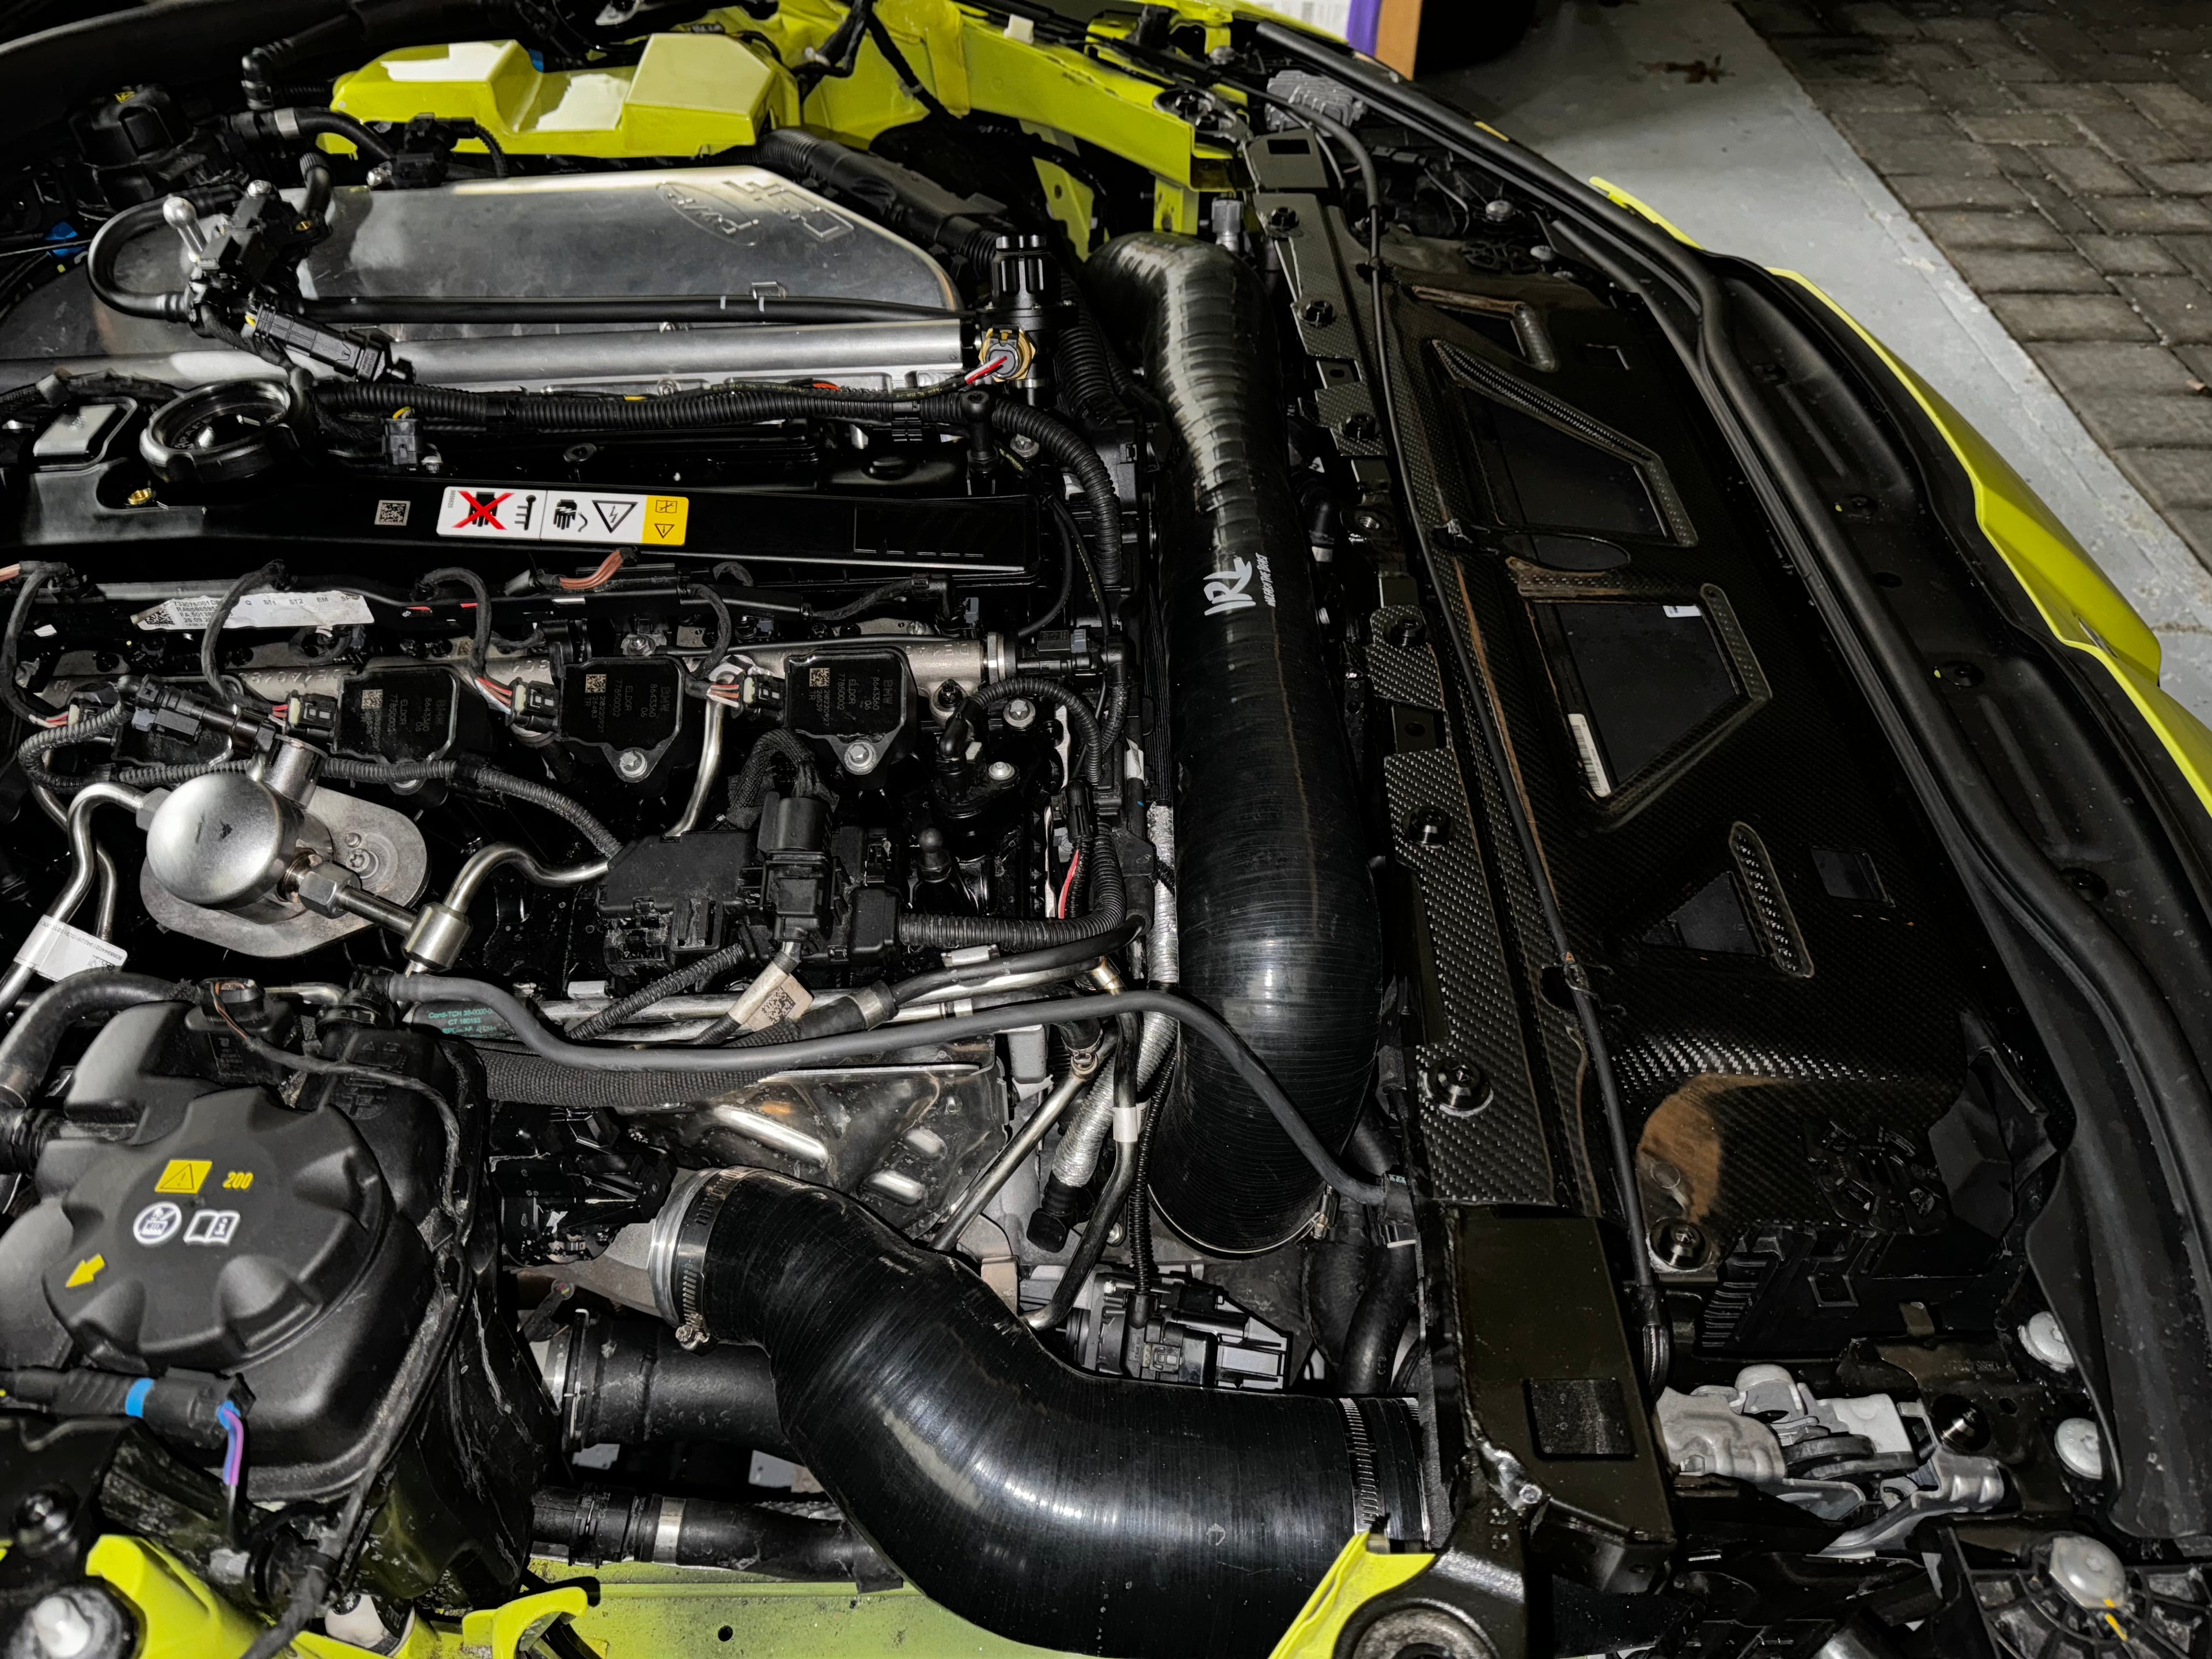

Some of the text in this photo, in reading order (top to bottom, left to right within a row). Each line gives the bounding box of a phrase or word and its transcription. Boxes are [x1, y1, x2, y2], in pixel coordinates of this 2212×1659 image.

[613, 679, 622, 717] 77850002
[624, 685, 633, 711] ELDOR
[808, 690, 816, 700] TR
[837, 673, 845, 710] 77850002
[584, 696, 591, 707] TR
[864, 700, 871, 710] 06
[399, 699, 408, 725] ELDOR
[641, 707, 648, 718] 06
[222, 1171, 254, 1190] 200
